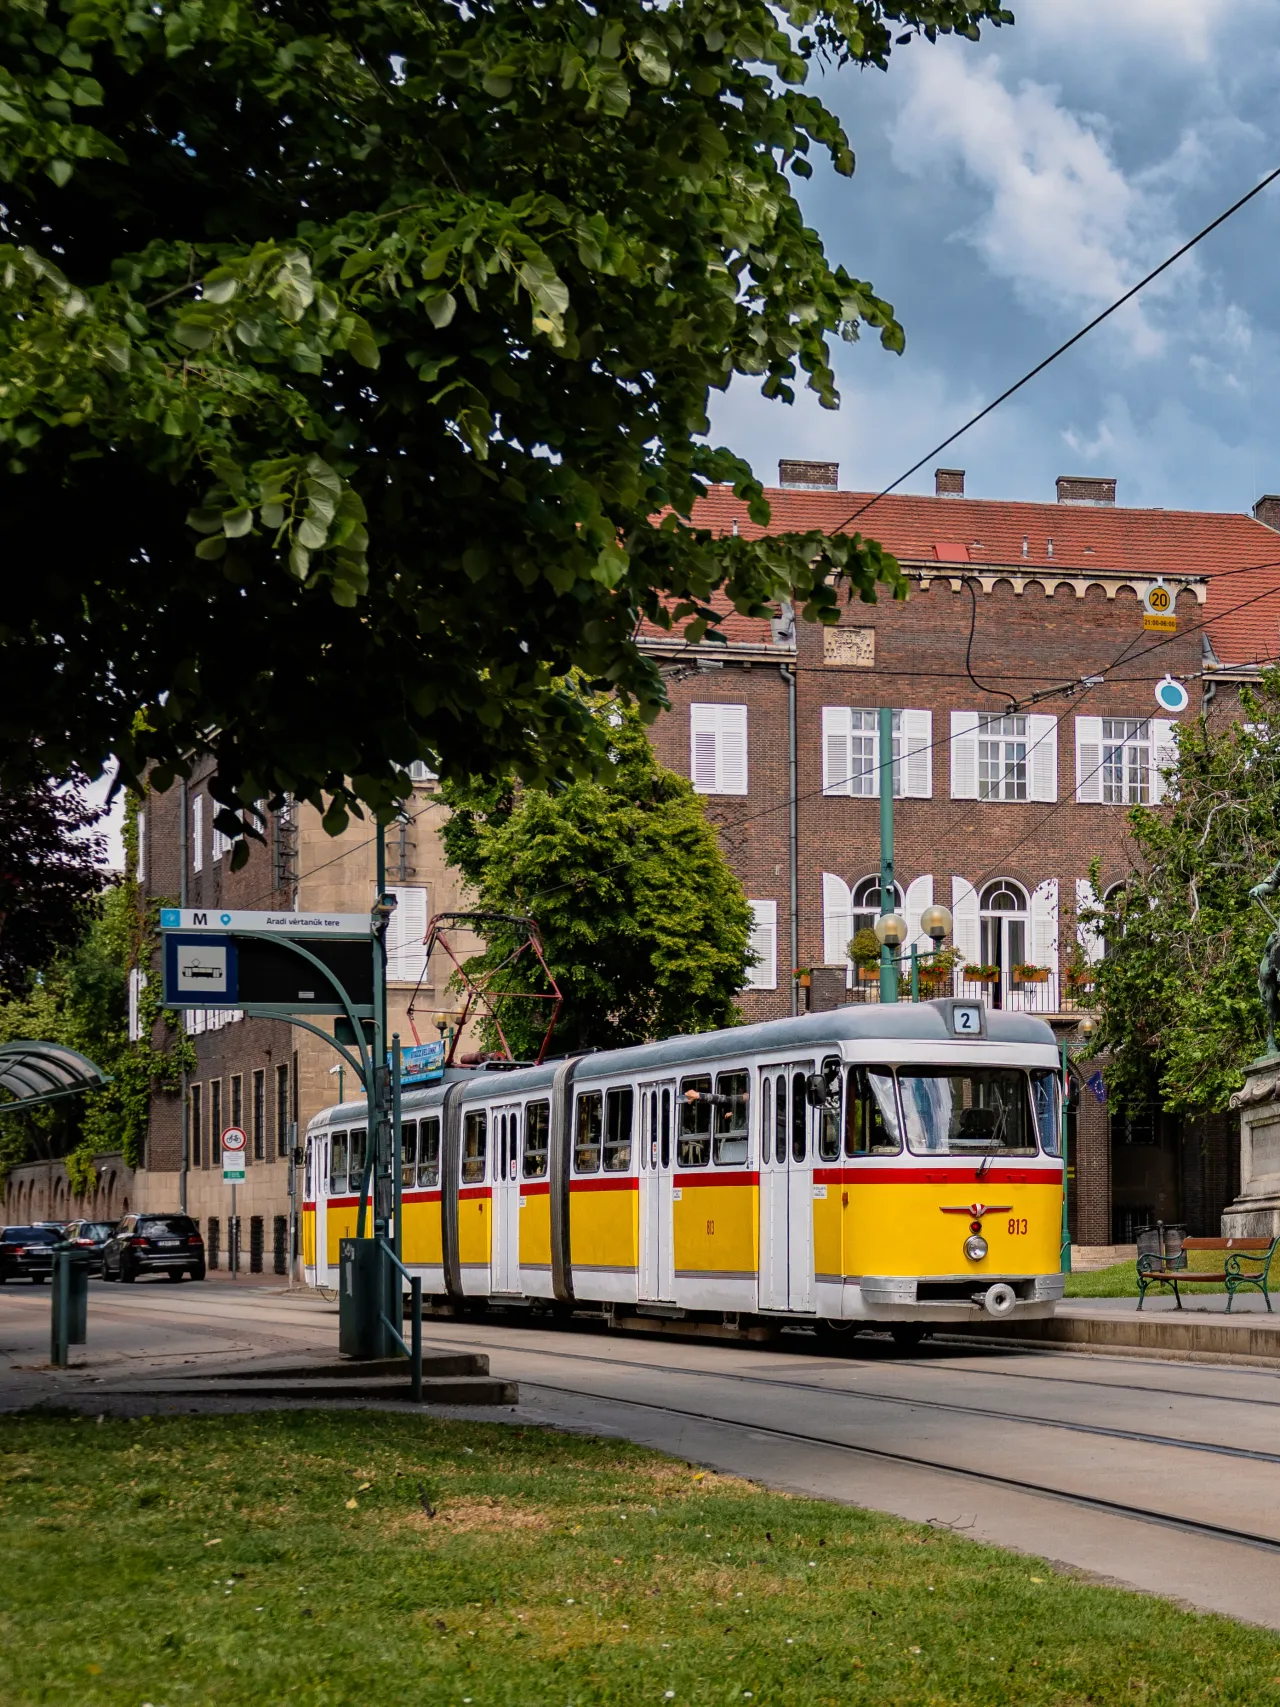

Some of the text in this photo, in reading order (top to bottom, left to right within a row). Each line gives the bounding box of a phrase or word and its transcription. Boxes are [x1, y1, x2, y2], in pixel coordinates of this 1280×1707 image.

[1152, 592, 1168, 607] 20
[1144, 619, 1175, 627] 21:00-06:00
[193, 913, 208, 926] M
[266, 917, 340, 927] Aradi vértanúk tere
[960, 1012, 972, 1029] 2
[706, 1219, 715, 1236] 813
[1008, 1218, 1028, 1235] 813
